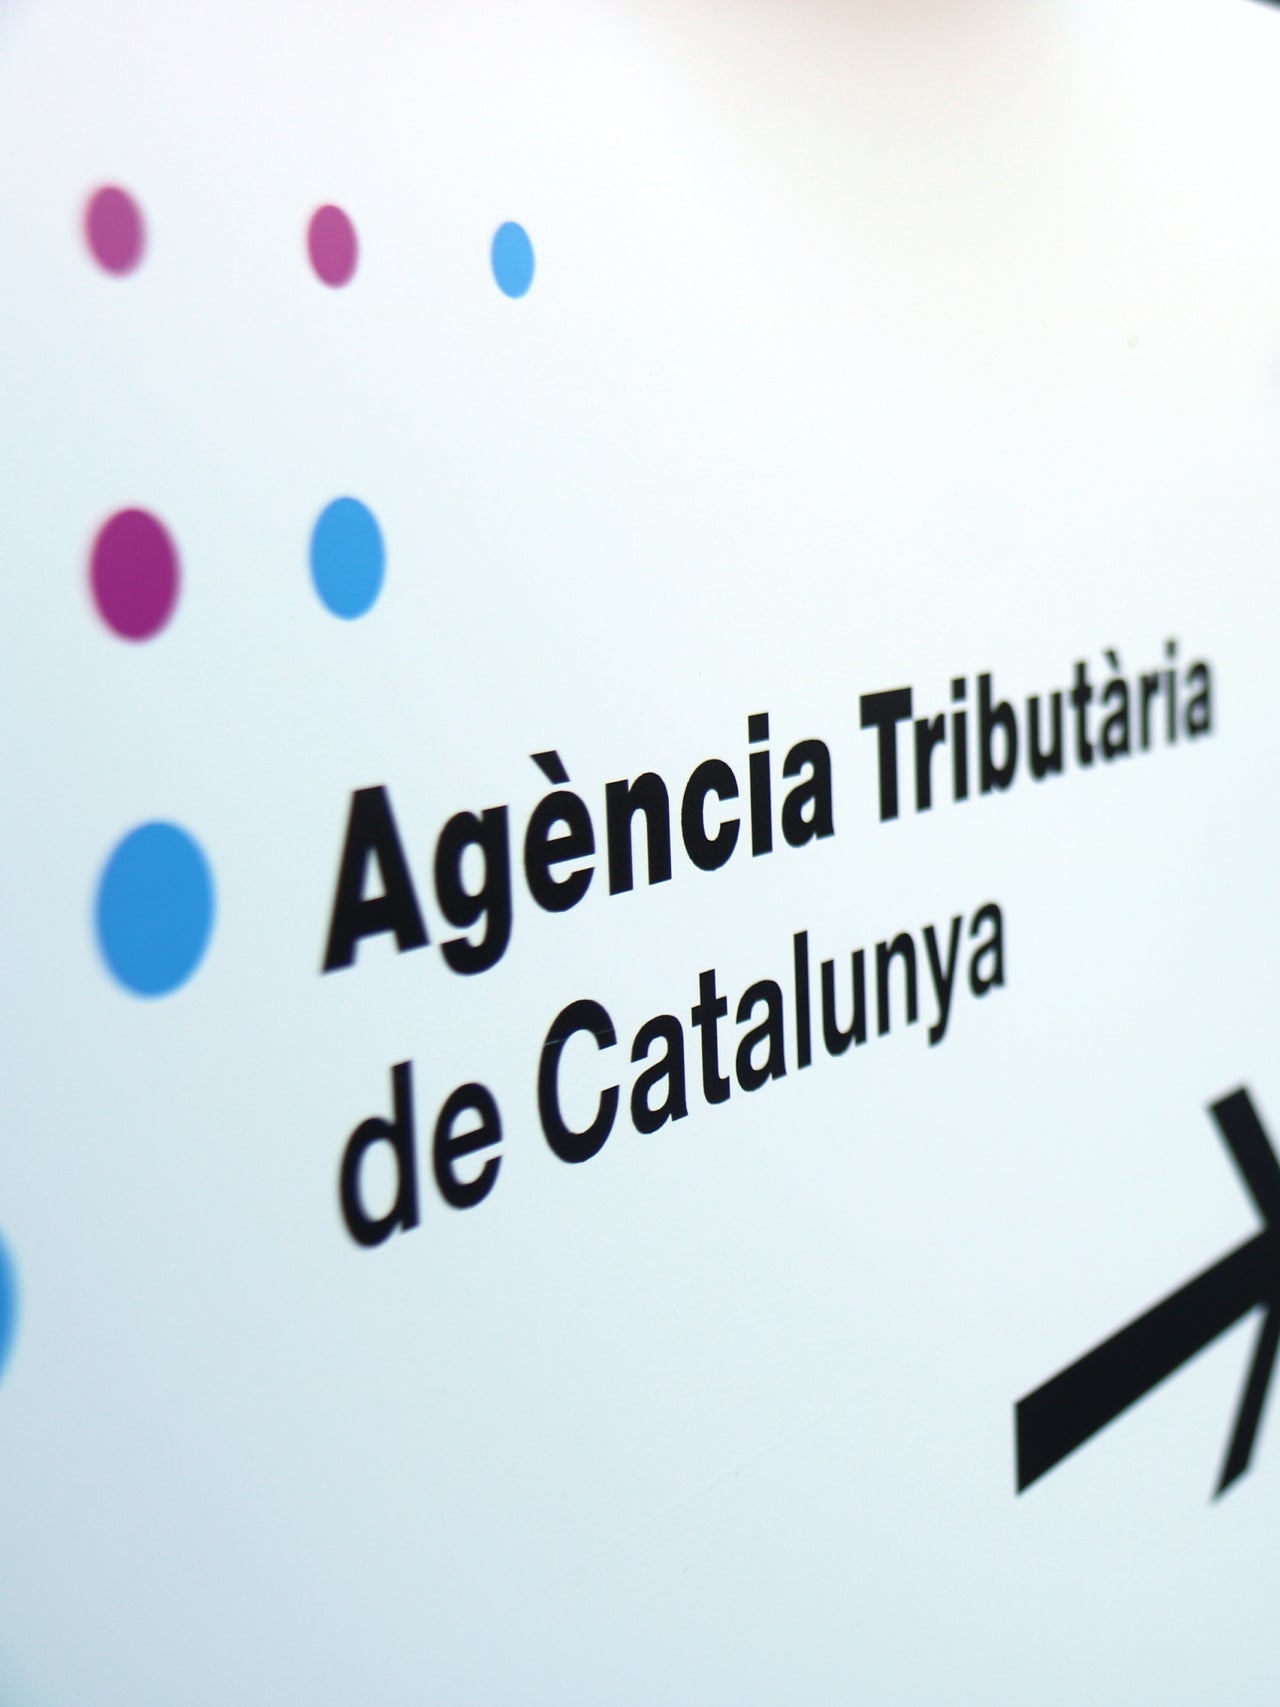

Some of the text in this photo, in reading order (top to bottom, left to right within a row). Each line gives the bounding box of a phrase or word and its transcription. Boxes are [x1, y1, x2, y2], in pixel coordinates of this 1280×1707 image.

[320, 636, 1215, 976] Agència Tributària
[336, 902, 1006, 1250] de Catalunya
